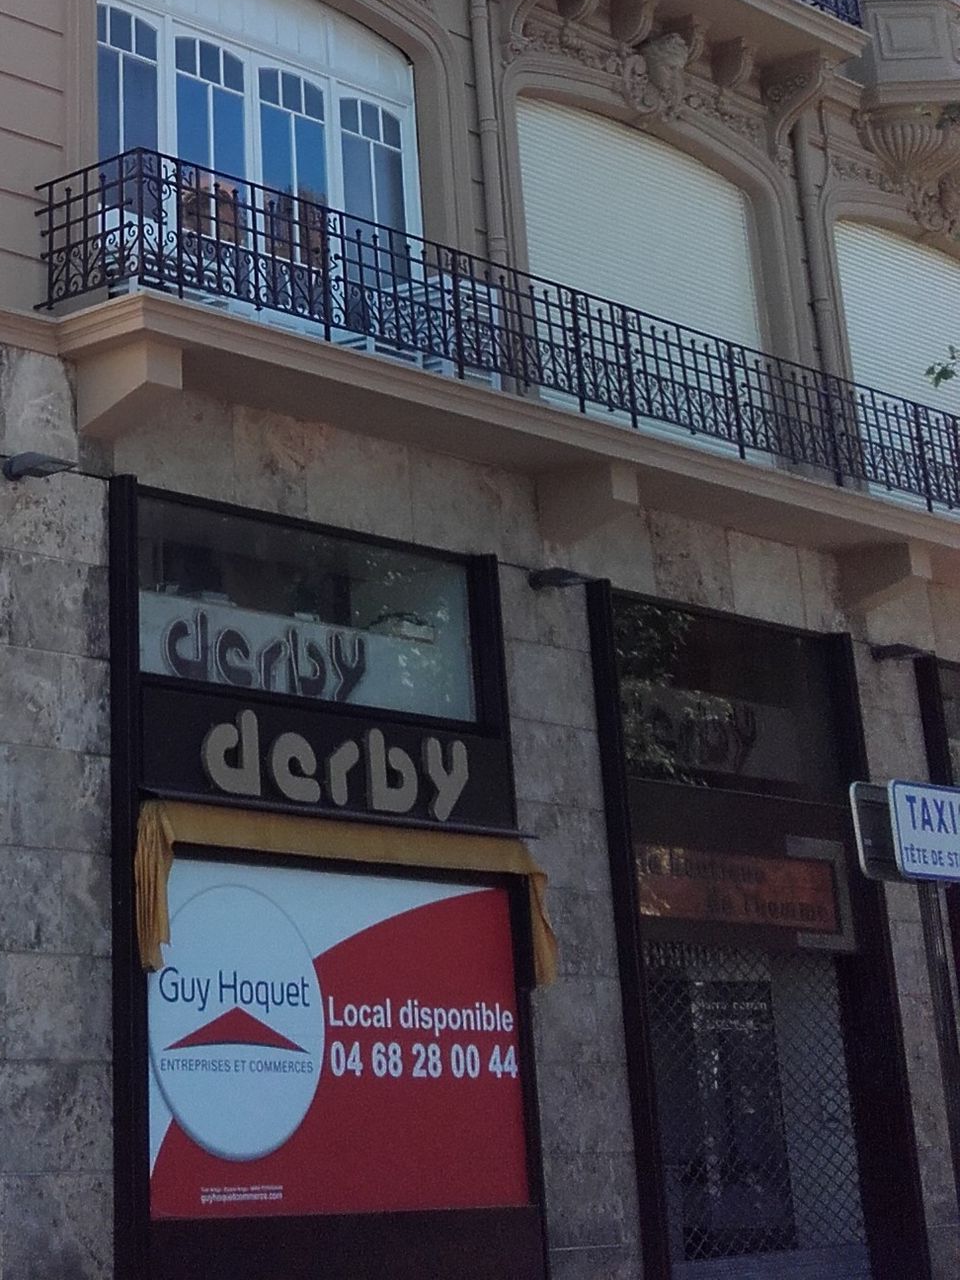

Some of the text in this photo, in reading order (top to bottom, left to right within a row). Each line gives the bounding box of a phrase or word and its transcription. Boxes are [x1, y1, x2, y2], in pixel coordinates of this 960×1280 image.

[162, 608, 365, 702] derby
[201, 709, 469, 821] derby
[905, 794, 960, 835] TAXI
[904, 843, 929, 864] TÊTE
[931, 849, 945, 866] DE
[159, 967, 310, 1013] Guy Hoquet
[329, 995, 514, 1037] Local disponible
[160, 1058, 313, 1074] ENTREPRISES ET COMMERCES
[330, 1040, 518, 1079] 04 68 28 00 44
